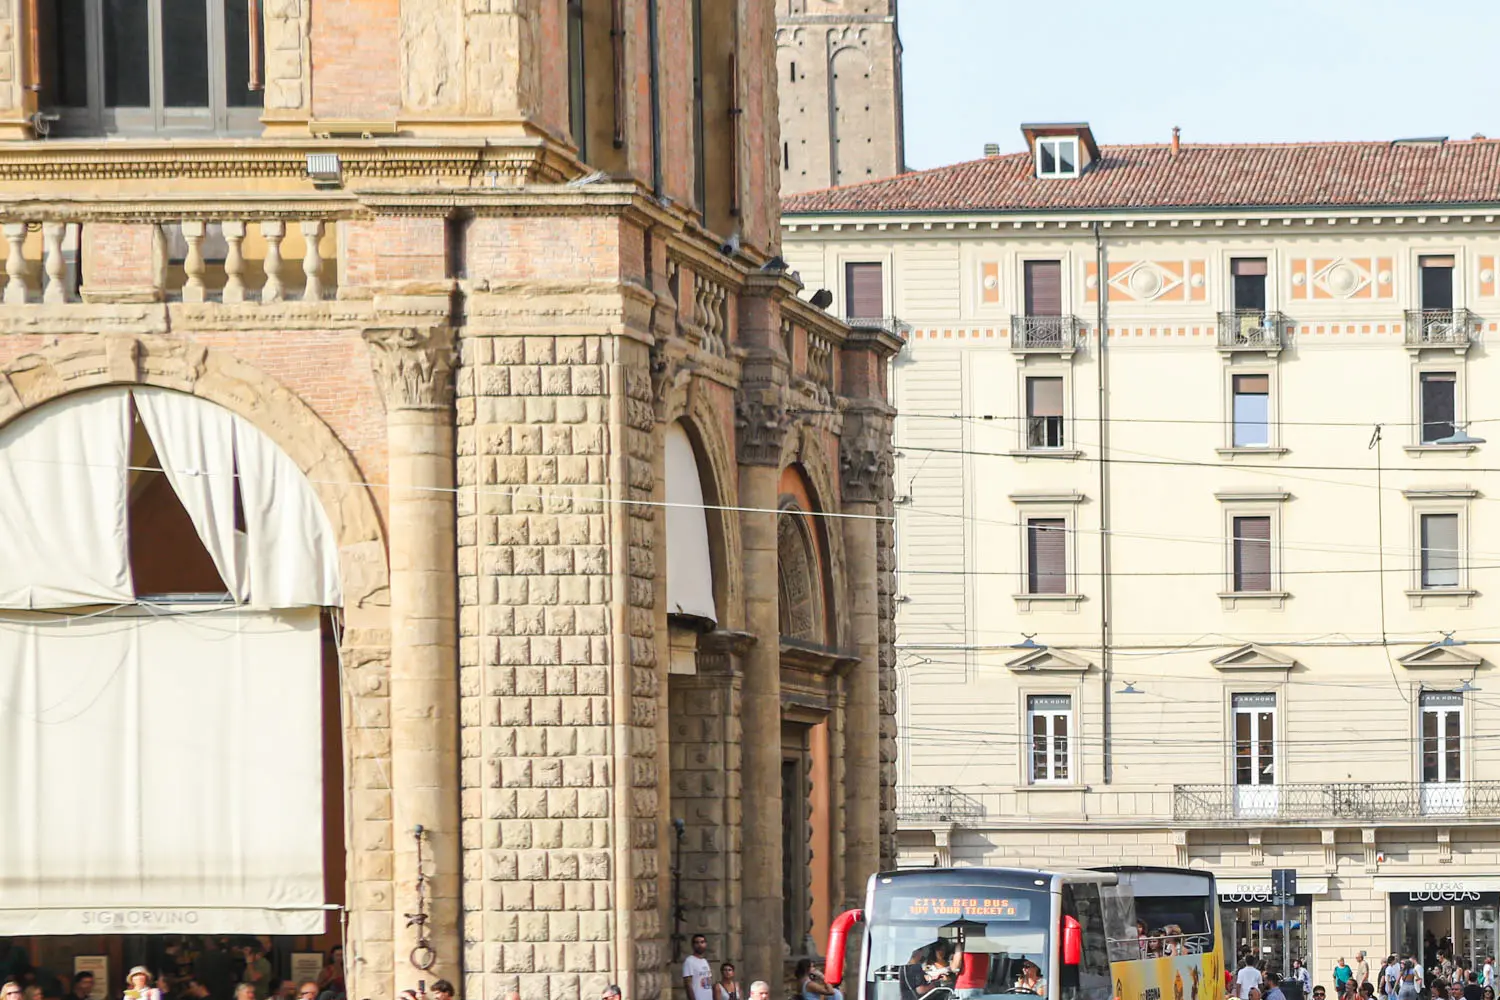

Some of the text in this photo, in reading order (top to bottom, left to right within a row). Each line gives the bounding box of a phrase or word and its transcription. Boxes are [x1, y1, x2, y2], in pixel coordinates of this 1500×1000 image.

[1425, 882, 1464, 891] DOUGLAS
[914, 898, 1009, 908] CITY RED BUS
[1221, 893, 1273, 903] DOUGL
[933, 906, 961, 915] YOUR
[965, 907, 1003, 916] TICKET
[82, 911, 198, 924] SIGNORVINO
